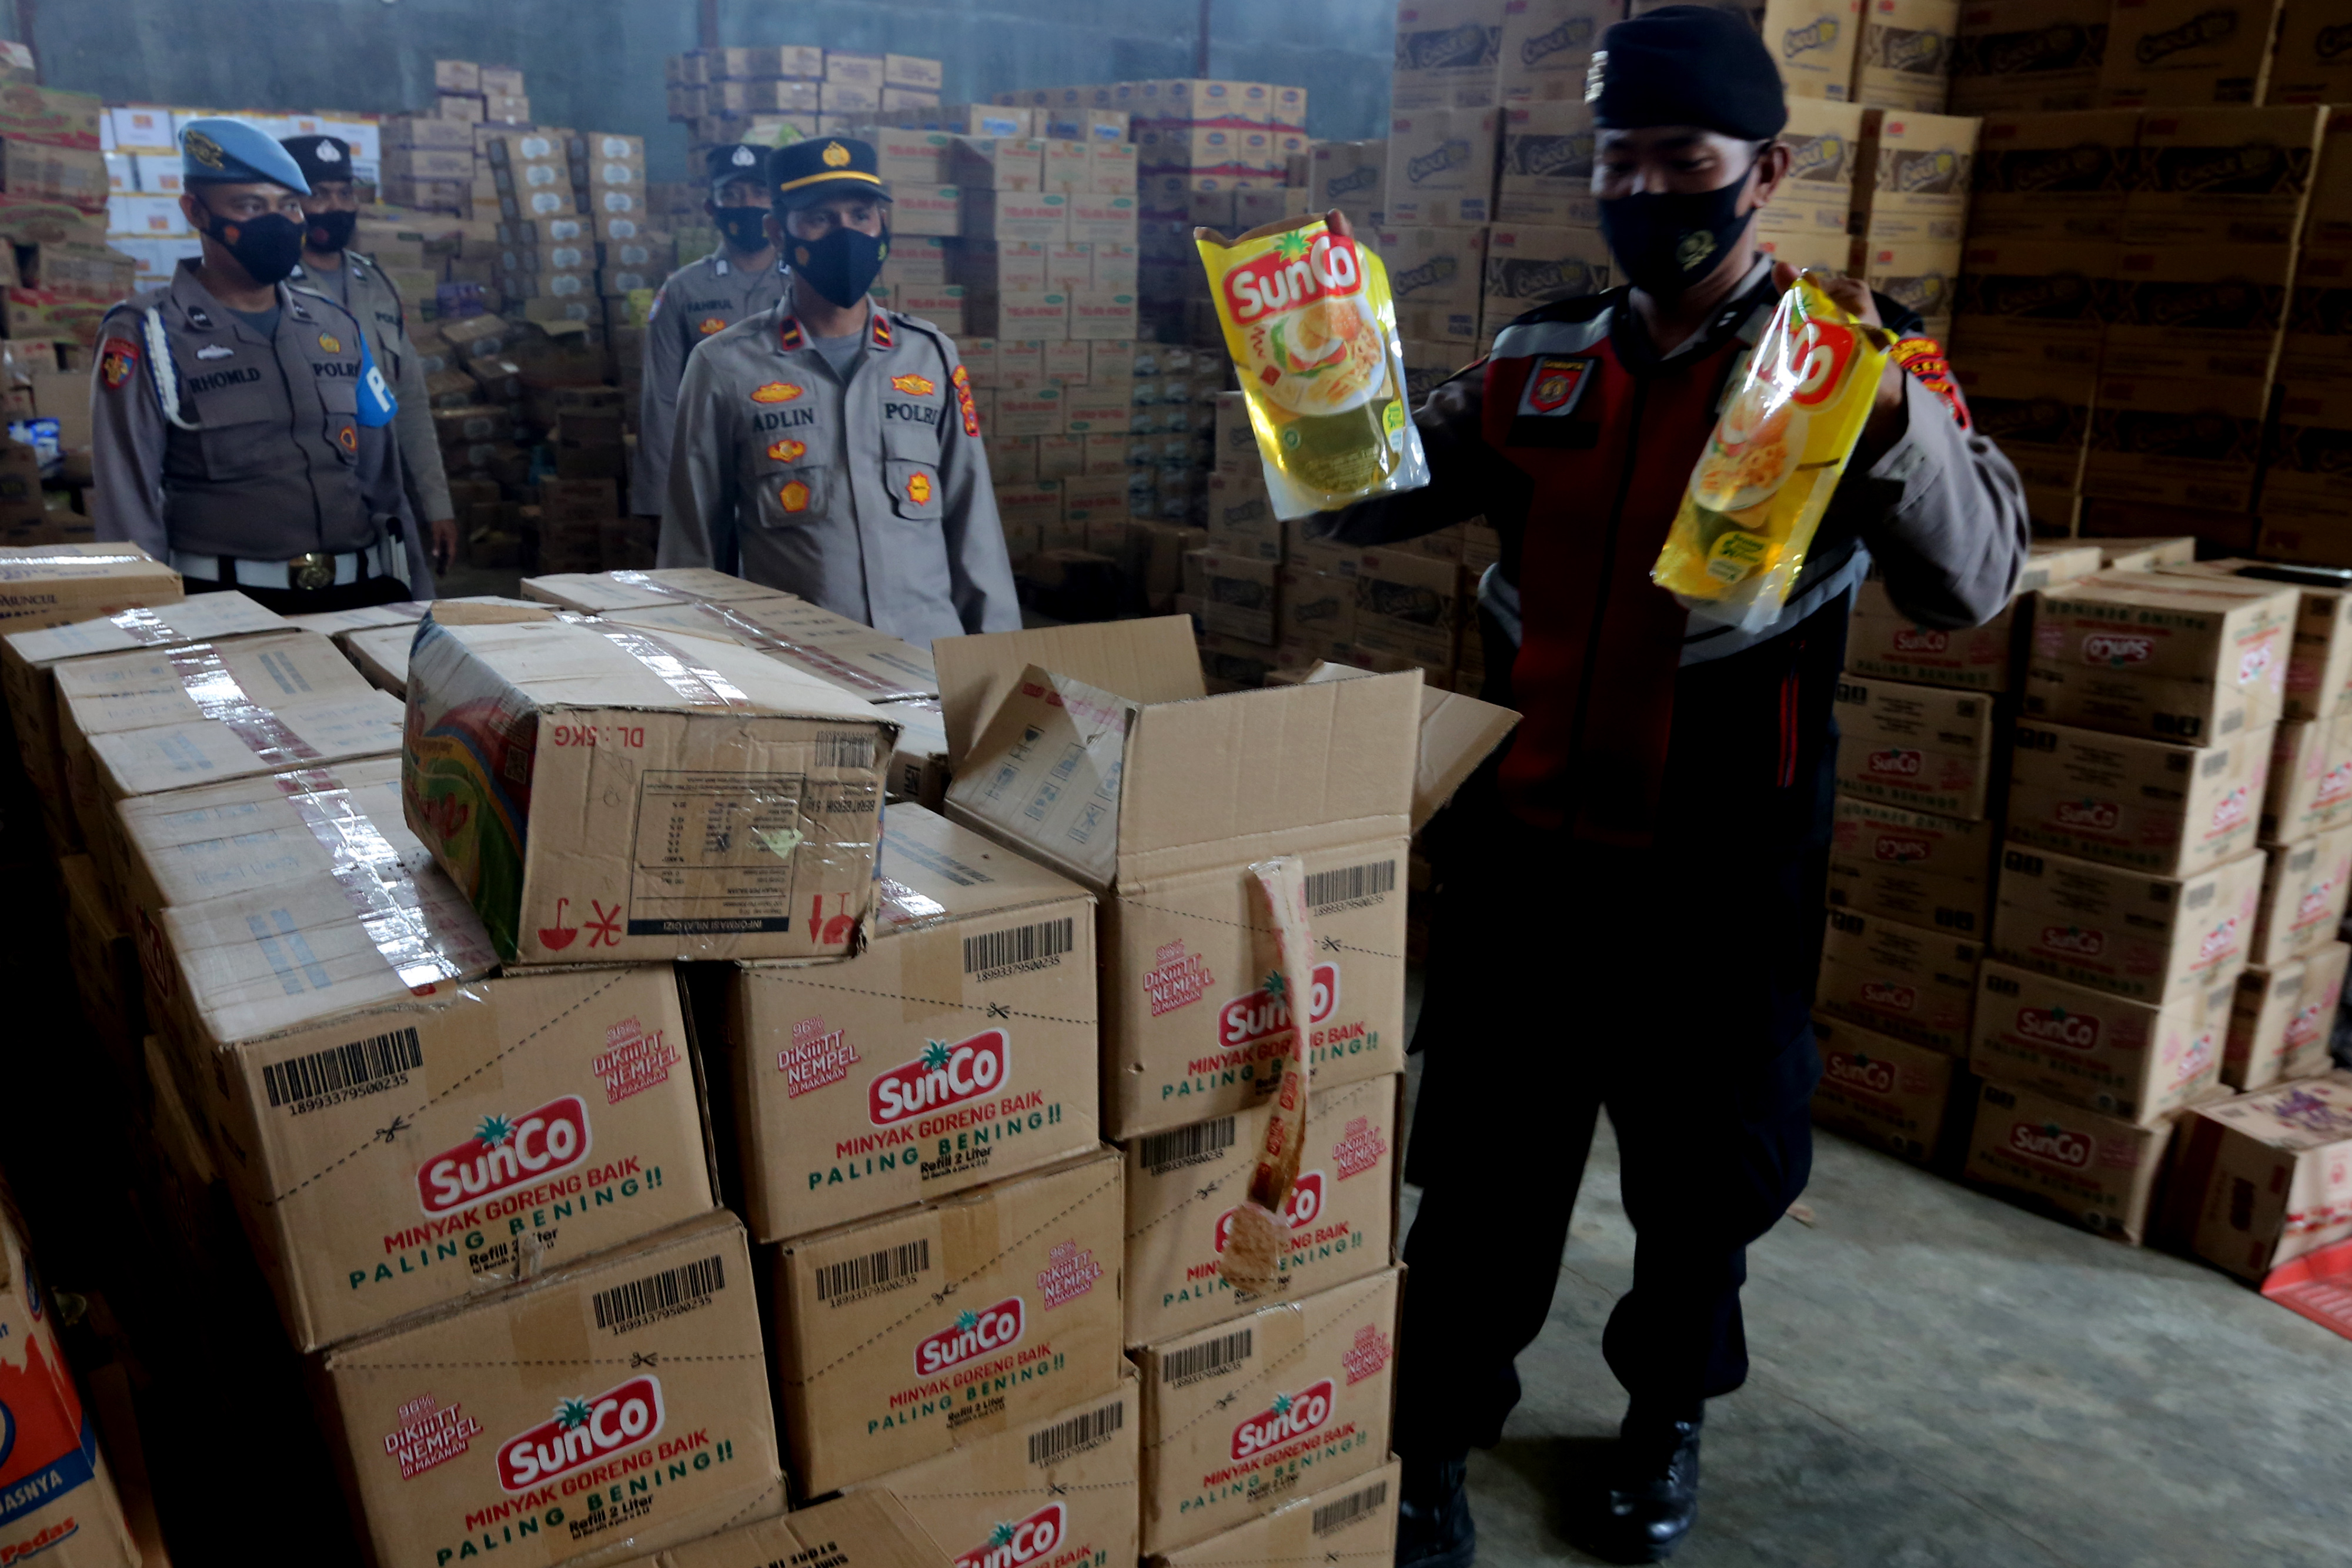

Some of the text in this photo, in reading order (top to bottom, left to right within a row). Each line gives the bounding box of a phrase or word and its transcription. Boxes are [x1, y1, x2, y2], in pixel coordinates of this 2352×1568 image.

[1232, 235, 1355, 317] SunCo
[754, 407, 814, 432] ADLIN
[554, 725, 597, 747] 5KG
[617, 727, 644, 748] DL
[684, 921, 709, 931] NILAI
[711, 920, 763, 930] INFORMASI
[975, 956, 1060, 983] 18993379500235
[793, 1014, 824, 1038] 96%
[1227, 982, 1329, 1042] Suno
[2021, 1011, 2094, 1048] SunCo
[604, 1044, 681, 1091] NEMPEL
[788, 1044, 861, 1086] NEMPEL
[1188, 1047, 1254, 1076] MINYAK
[1328, 1021, 1365, 1044] BAIK
[800, 1066, 846, 1094] MAKANAN
[878, 1047, 997, 1119] SunCo
[1162, 1065, 1254, 1101] PALING
[1830, 1055, 1890, 1091] SunCo
[289, 1073, 409, 1116] 18993379500235
[836, 1089, 1044, 1159] MINYAK GORENG BAIK
[430, 1116, 579, 1206] SunCo
[920, 1146, 992, 1173] Refill 2 Liter
[2015, 1125, 2086, 1164] SunCo
[808, 1146, 918, 1190] PALING
[383, 1155, 641, 1255] MINYAK GORENG BAIK
[1314, 1221, 1349, 1244] BAIK
[349, 1230, 485, 1289] PALING
[469, 1242, 507, 1266] Refill
[1044, 1261, 1104, 1300] NEMPEL
[1163, 1278, 1232, 1308] PALIN
[613, 1295, 713, 1335] 18993379500235
[923, 1312, 1015, 1371] SunCo
[890, 1342, 1052, 1409] MINYAK GORENG BAIK
[867, 1395, 952, 1435] PALING
[1238, 1395, 1327, 1456] SunCo
[397, 1416, 483, 1466] NEMPEL
[414, 1439, 469, 1473] MAKANAN
[509, 1398, 649, 1484] SunCo
[1203, 1456, 1260, 1488] MINYAK
[1264, 1435, 1321, 1467] GORENG
[1323, 1421, 1356, 1445] BAIK
[465, 1427, 710, 1533] MINYAK GORENG BAIK
[1180, 1475, 1259, 1513] PALING
[569, 1493, 654, 1533] Refill 2 Liter
[0, 1516, 76, 1564] Pedas
[436, 1506, 564, 1567] PALING
